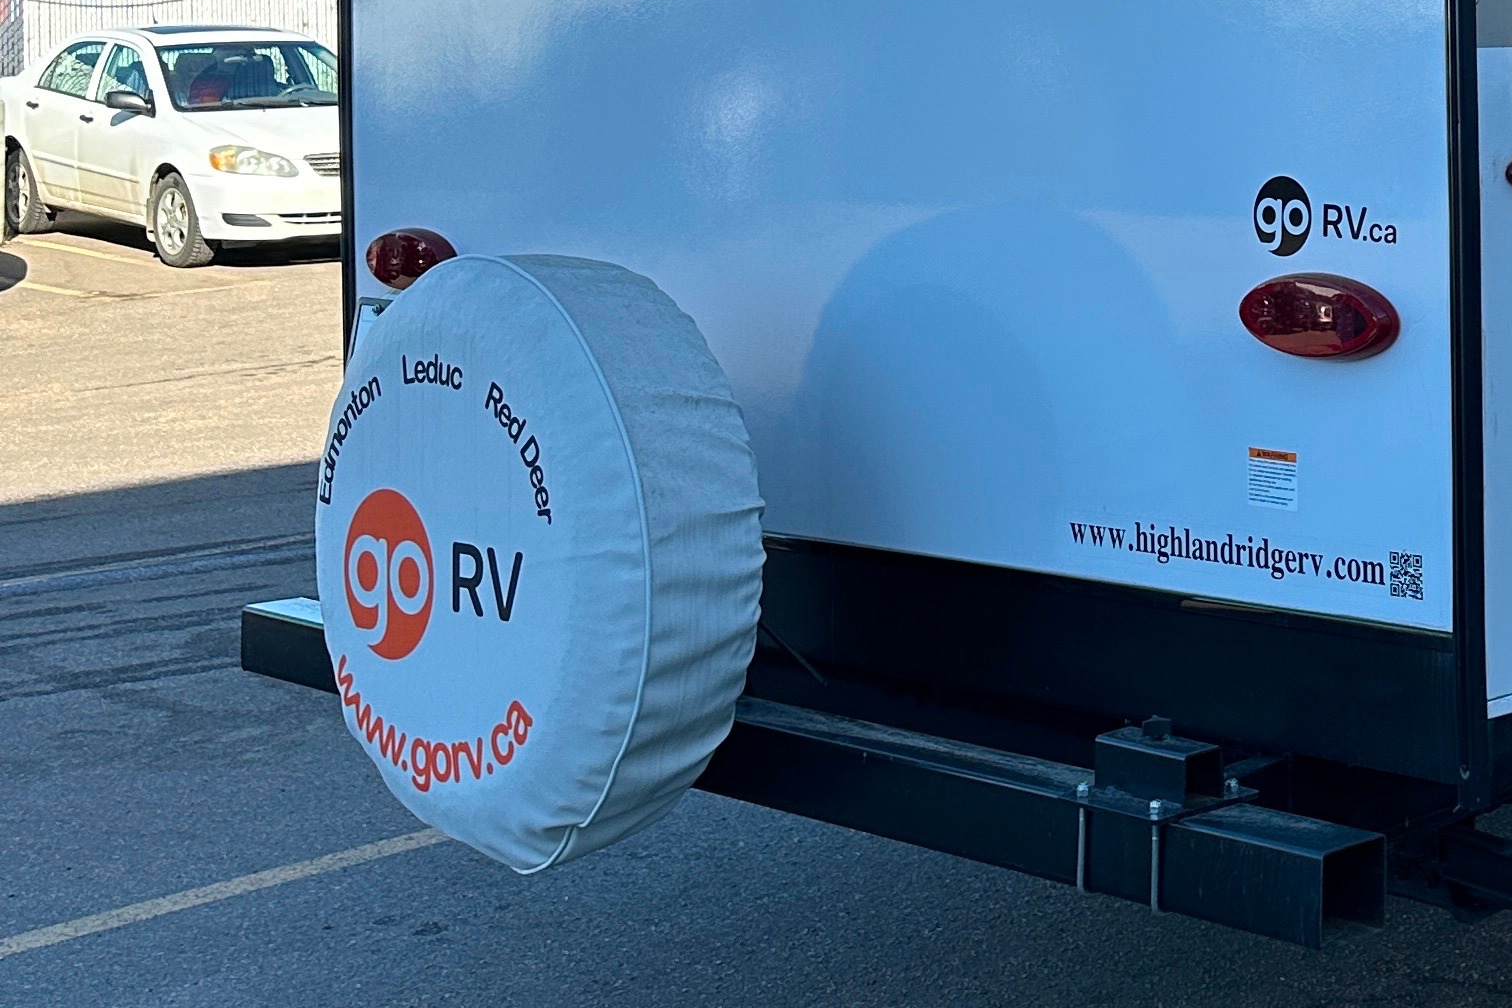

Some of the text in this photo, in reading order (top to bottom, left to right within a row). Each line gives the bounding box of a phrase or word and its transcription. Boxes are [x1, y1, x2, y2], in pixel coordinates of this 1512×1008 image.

[1255, 196, 1398, 255] go RV.ca
[401, 353, 463, 390] Leduc
[319, 376, 382, 506] Edmonton
[484, 381, 553, 526] Red Deer
[346, 532, 524, 652] go RV
[1069, 521, 1386, 586] www.highlandridgerv.com
[337, 654, 534, 793] www.gorv.ca
